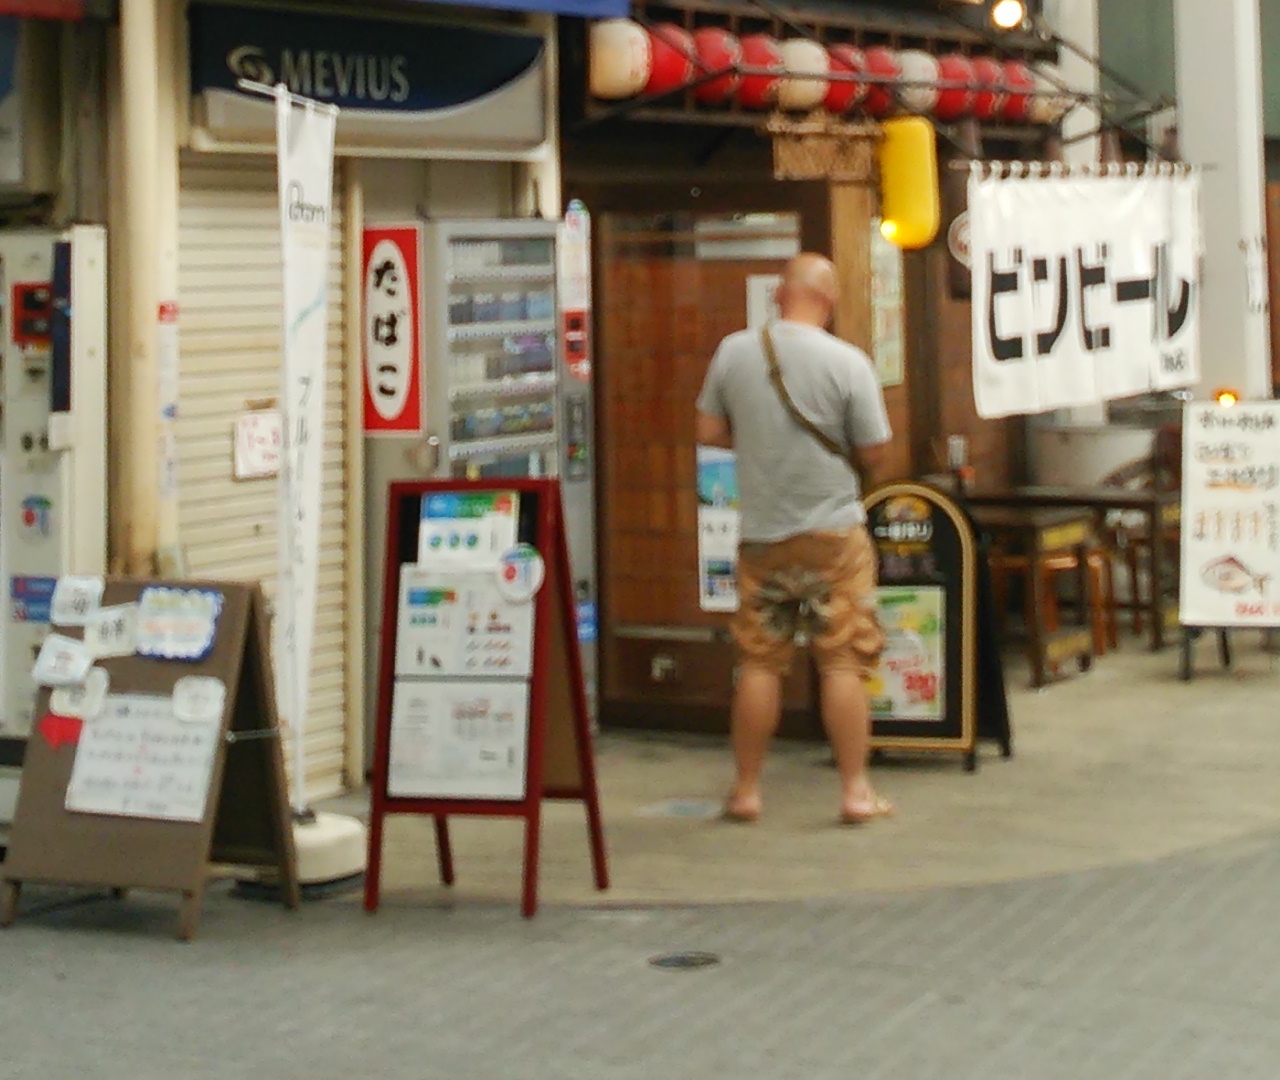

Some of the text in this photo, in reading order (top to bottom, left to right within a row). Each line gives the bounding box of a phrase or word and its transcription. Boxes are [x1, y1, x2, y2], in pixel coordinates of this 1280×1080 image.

[278, 48, 410, 104] MEVIUS
[372, 257, 405, 398] たばこ
